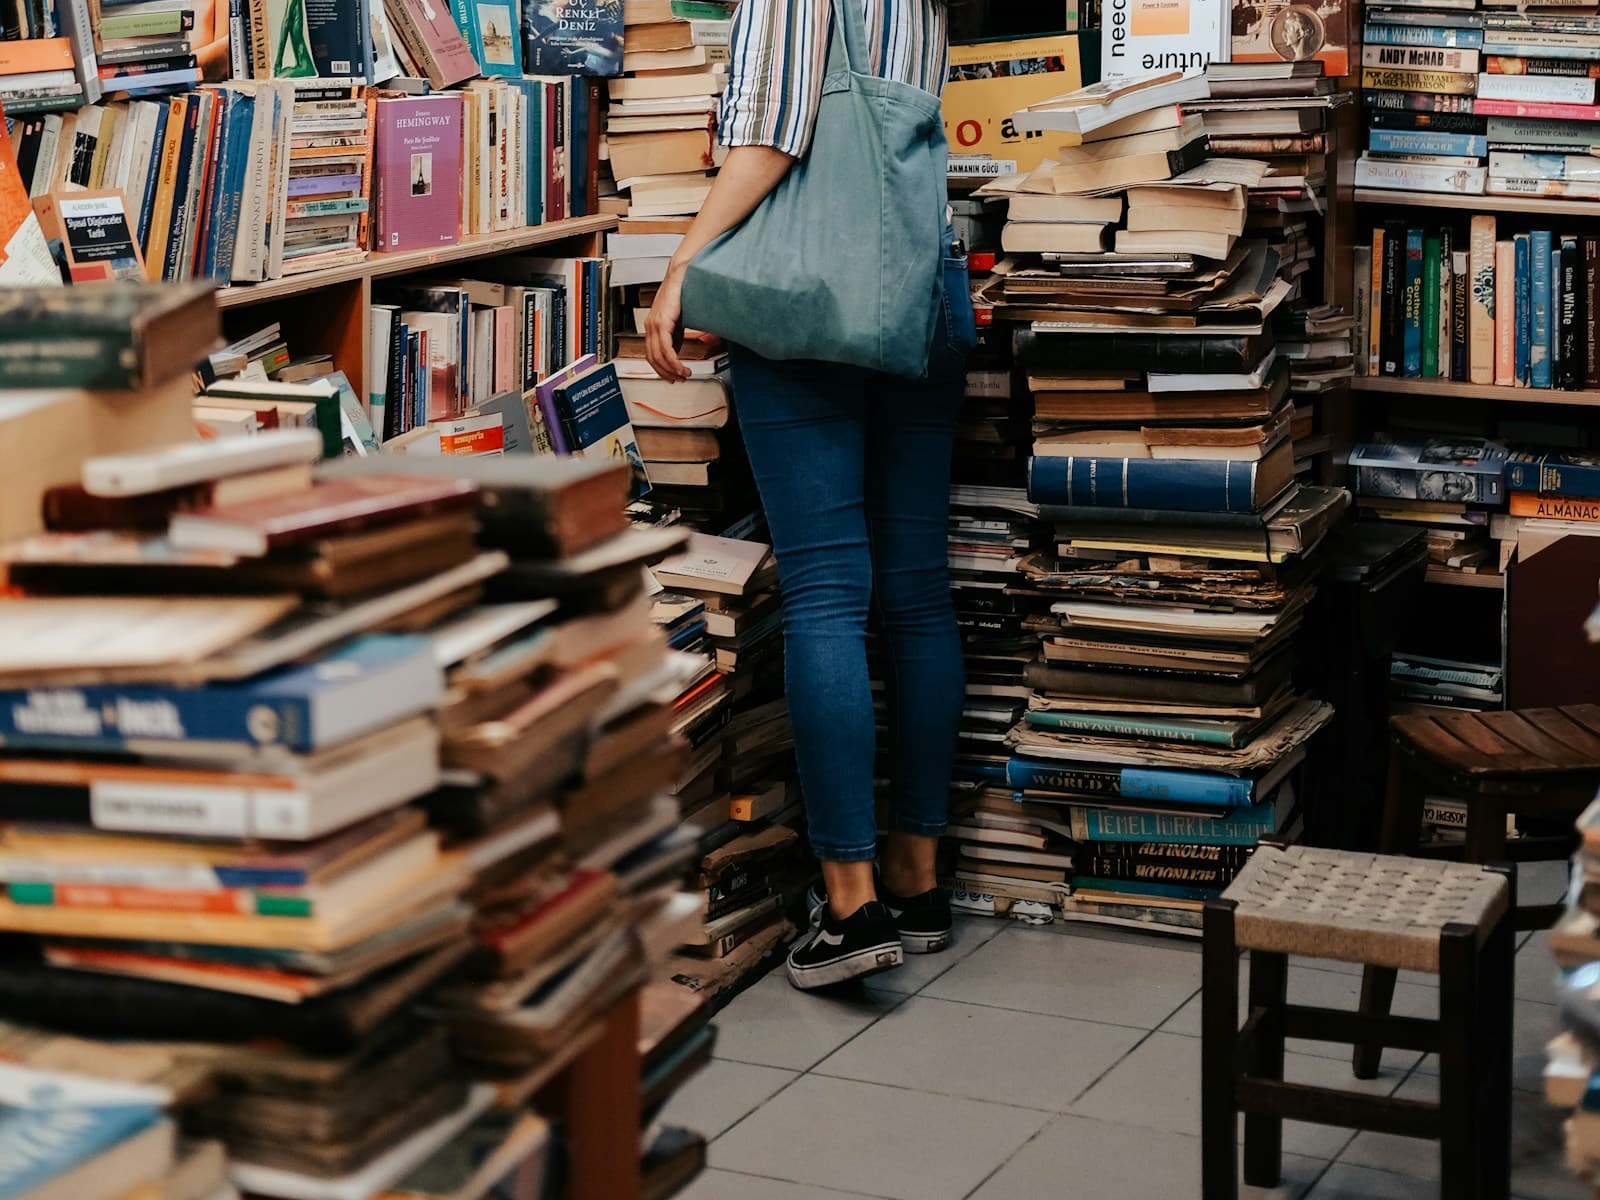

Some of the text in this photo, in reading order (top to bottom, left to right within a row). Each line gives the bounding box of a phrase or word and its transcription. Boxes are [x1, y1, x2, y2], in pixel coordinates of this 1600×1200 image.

[555, 6, 602, 19] RENKLİ
[558, 19, 597, 32] DENİZ
[1370, 28, 1434, 44] TIM WINTON
[1379, 48, 1445, 67] ANDY McNAB
[1373, 79, 1399, 88] JAMES
[1384, 72, 1406, 81] GOES
[1377, 99, 1405, 109] LOWELL
[396, 115, 451, 129] HEMINGWAY
[981, 161, 999, 173] GÜCÜ
[1482, 230, 1494, 305] AMERICAN
[1405, 285, 1414, 319] Cross
[1412, 277, 1422, 327] Southern
[1455, 273, 1466, 343] LOST EMPIRES
[1562, 292, 1575, 325] White
[526, 300, 536, 381] BABALARDAN BABALARA
[1537, 501, 1600, 519] ALMANAC
[1031, 774, 1103, 792] WORLD
[1093, 810, 1154, 837] TEMEL
[1137, 841, 1221, 860] ALTINOLUK
[1134, 863, 1217, 881] ALTINOLUK
